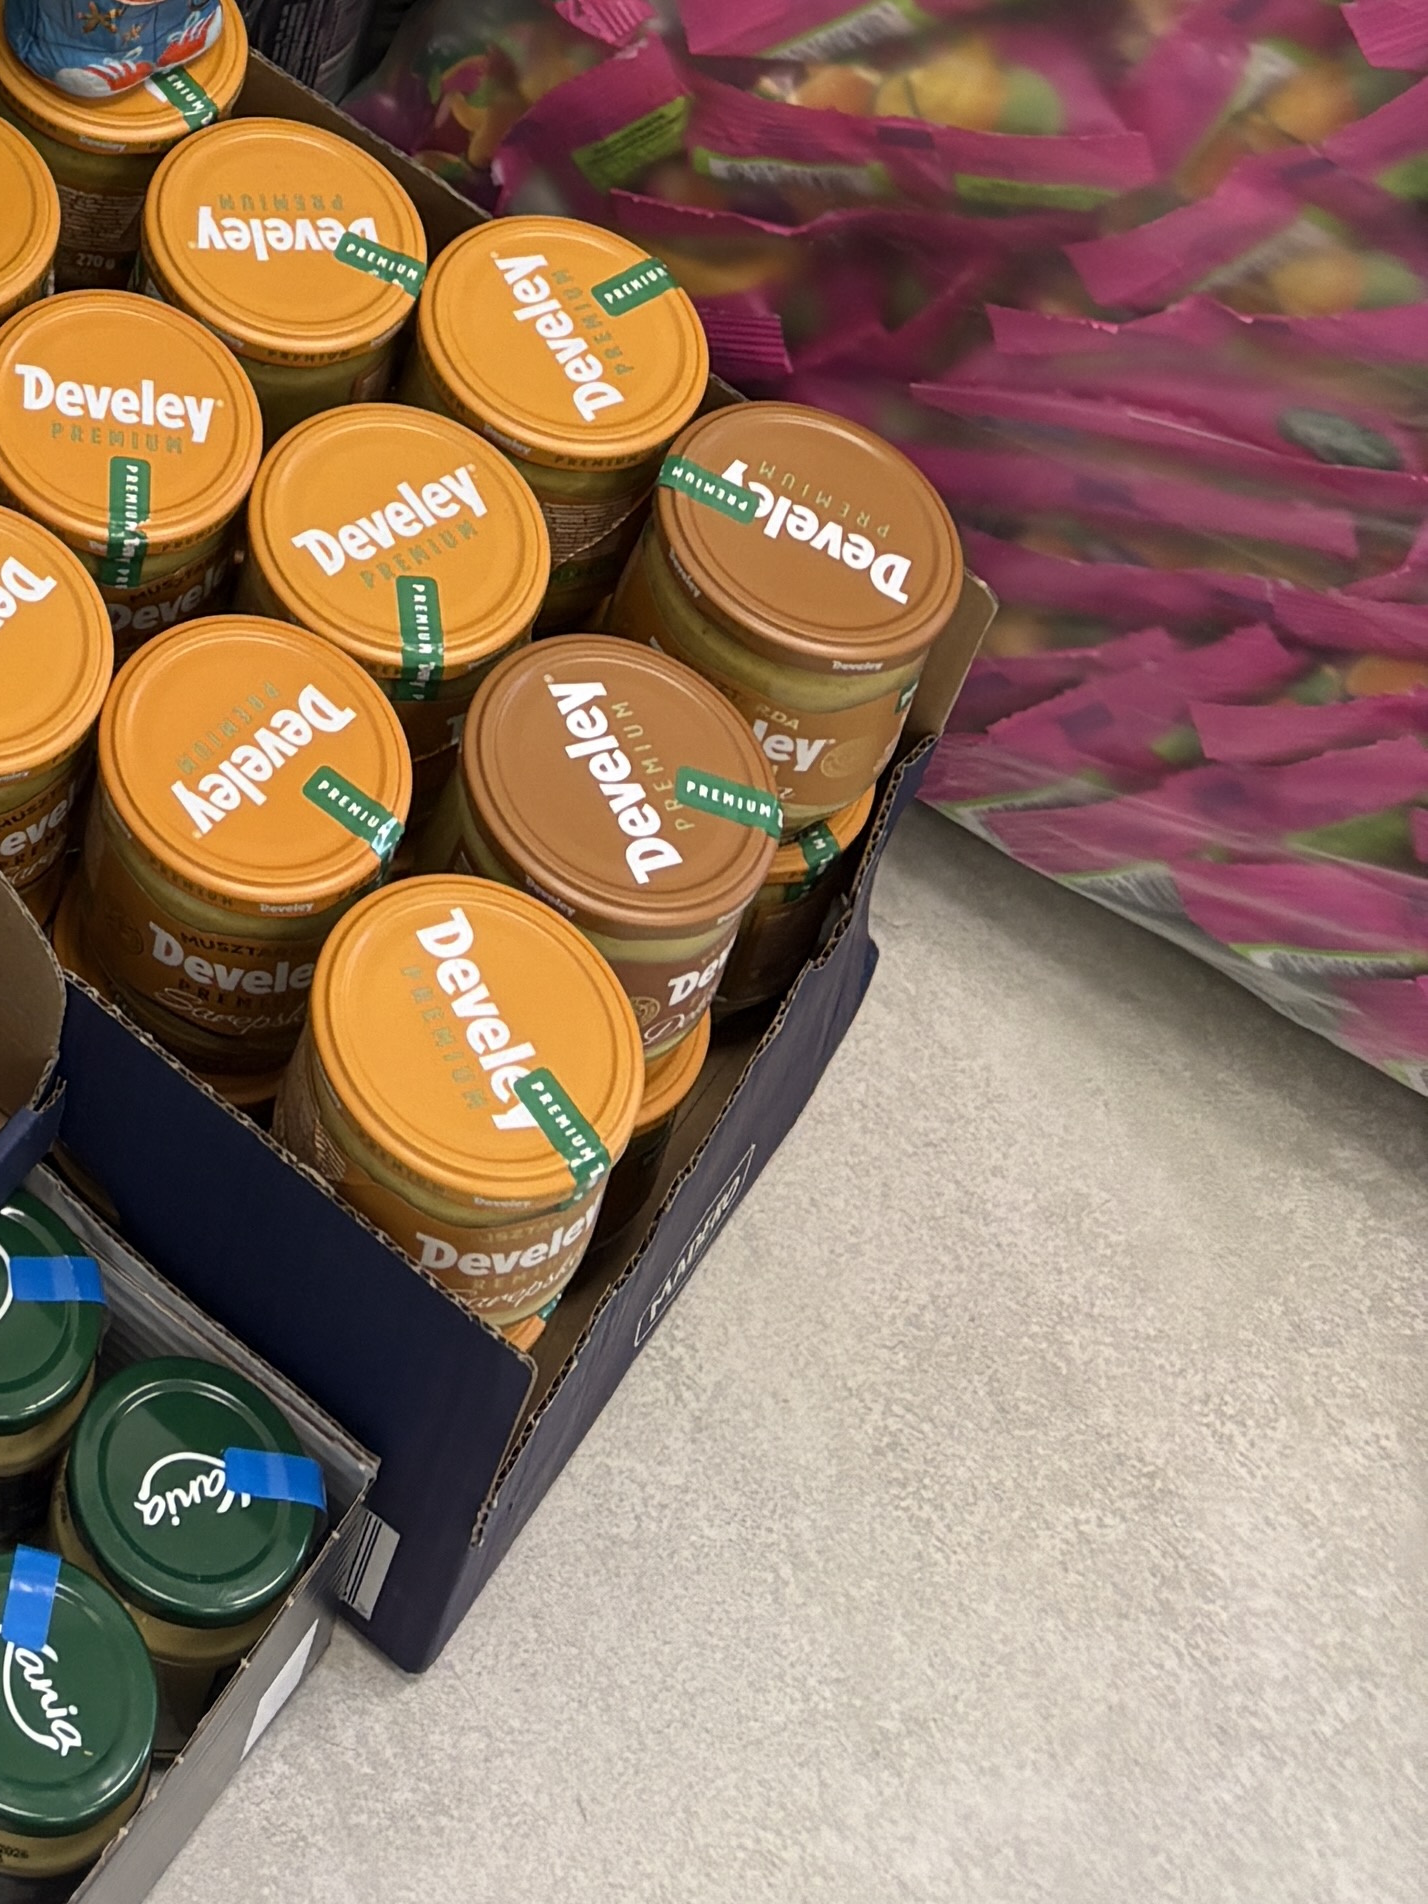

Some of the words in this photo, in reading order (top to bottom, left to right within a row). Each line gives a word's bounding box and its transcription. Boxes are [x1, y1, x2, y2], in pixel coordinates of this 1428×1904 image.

[345, 241, 420, 281] PREMIUM
[603, 266, 669, 305] PREMIUM
[492, 252, 624, 422] Develey
[14, 365, 221, 443] Develey
[123, 465, 139, 524] PREMIUM
[291, 464, 488, 577] Develey
[171, 683, 358, 840] Develey
[544, 672, 685, 884] Develey
